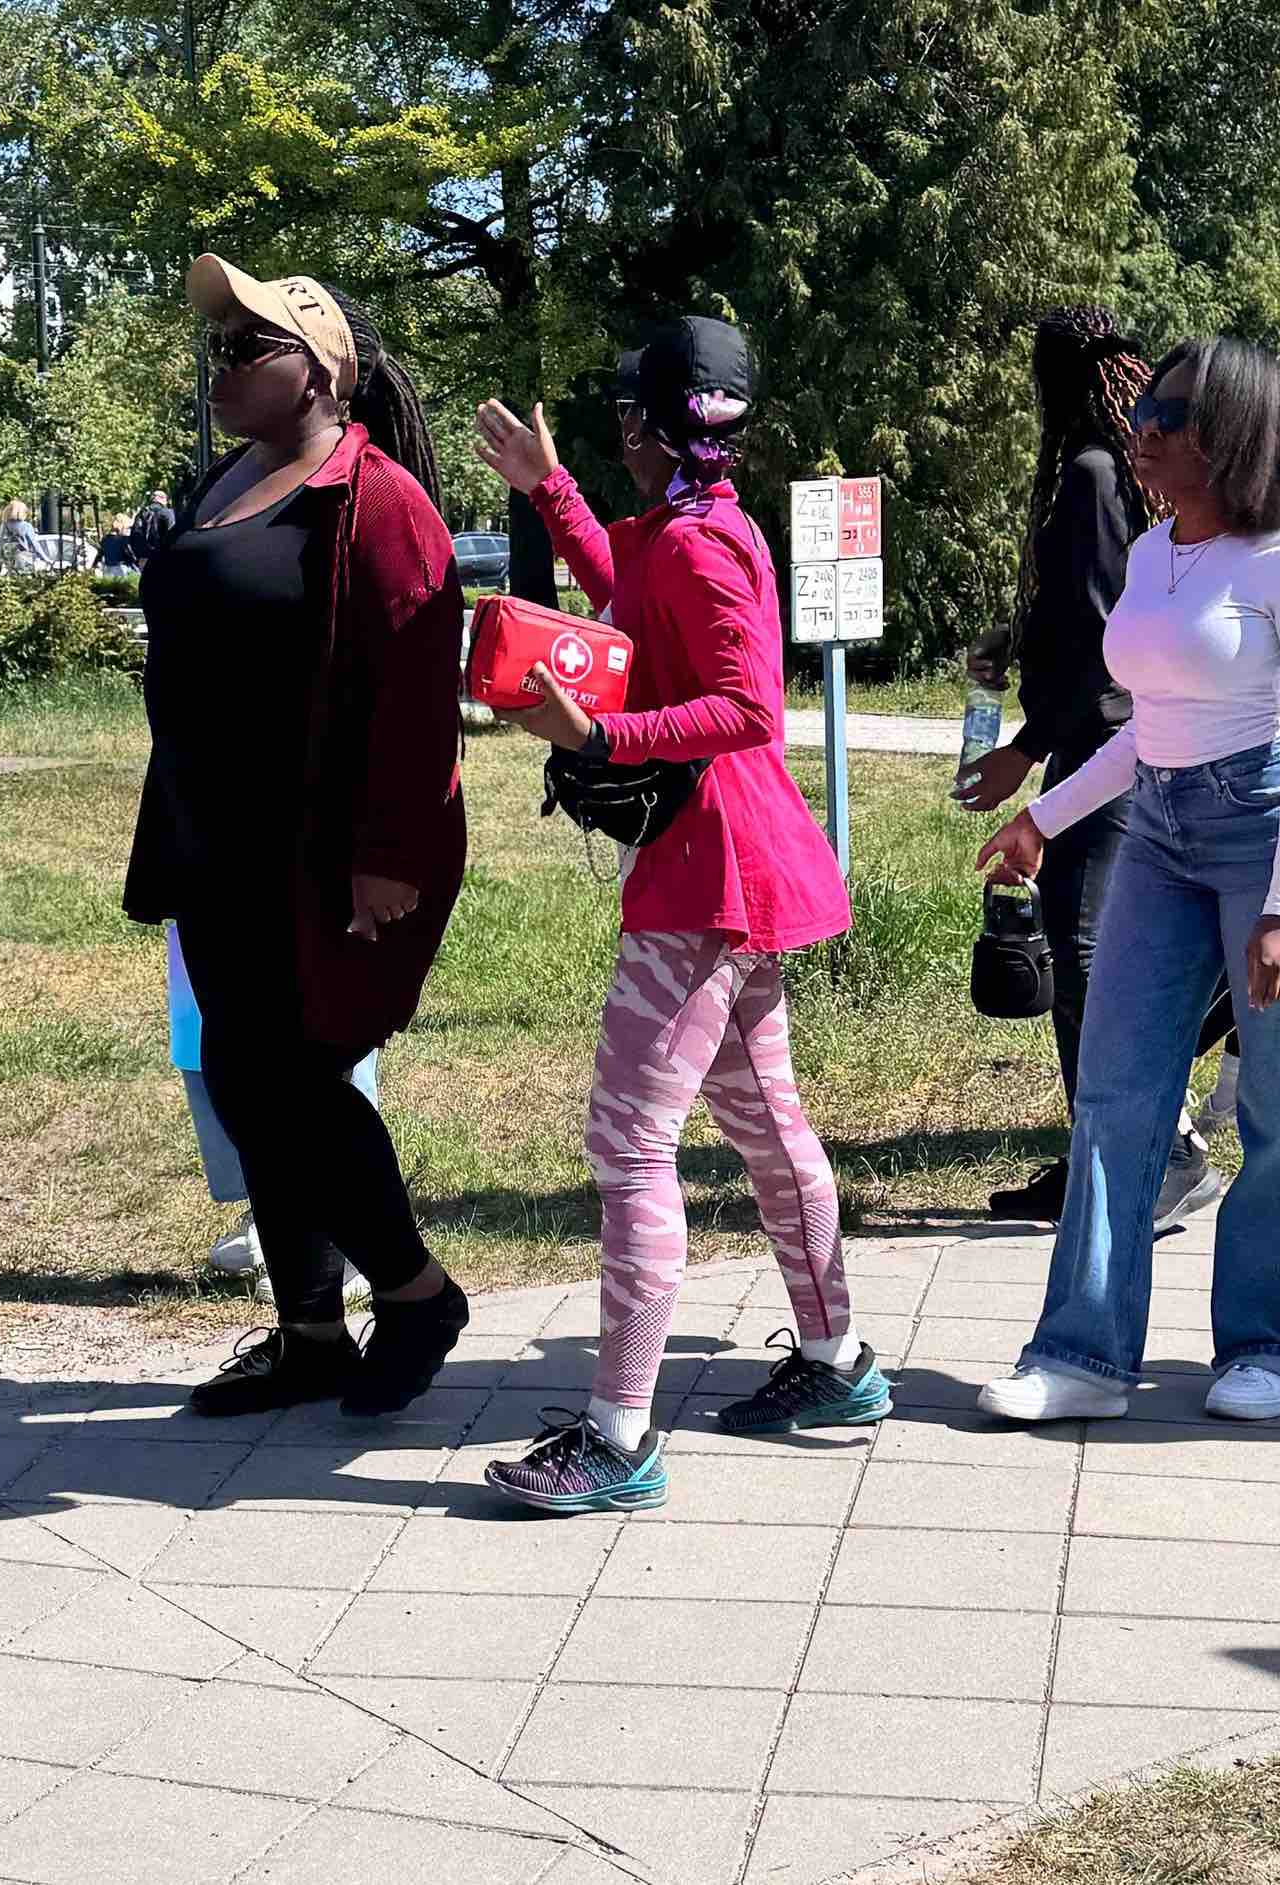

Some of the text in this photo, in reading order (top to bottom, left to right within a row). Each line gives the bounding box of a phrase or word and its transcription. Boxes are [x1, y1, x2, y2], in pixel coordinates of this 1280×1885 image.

[797, 575, 810, 597] Z
[841, 571, 855, 594] Z
[579, 691, 600, 706] KIT
